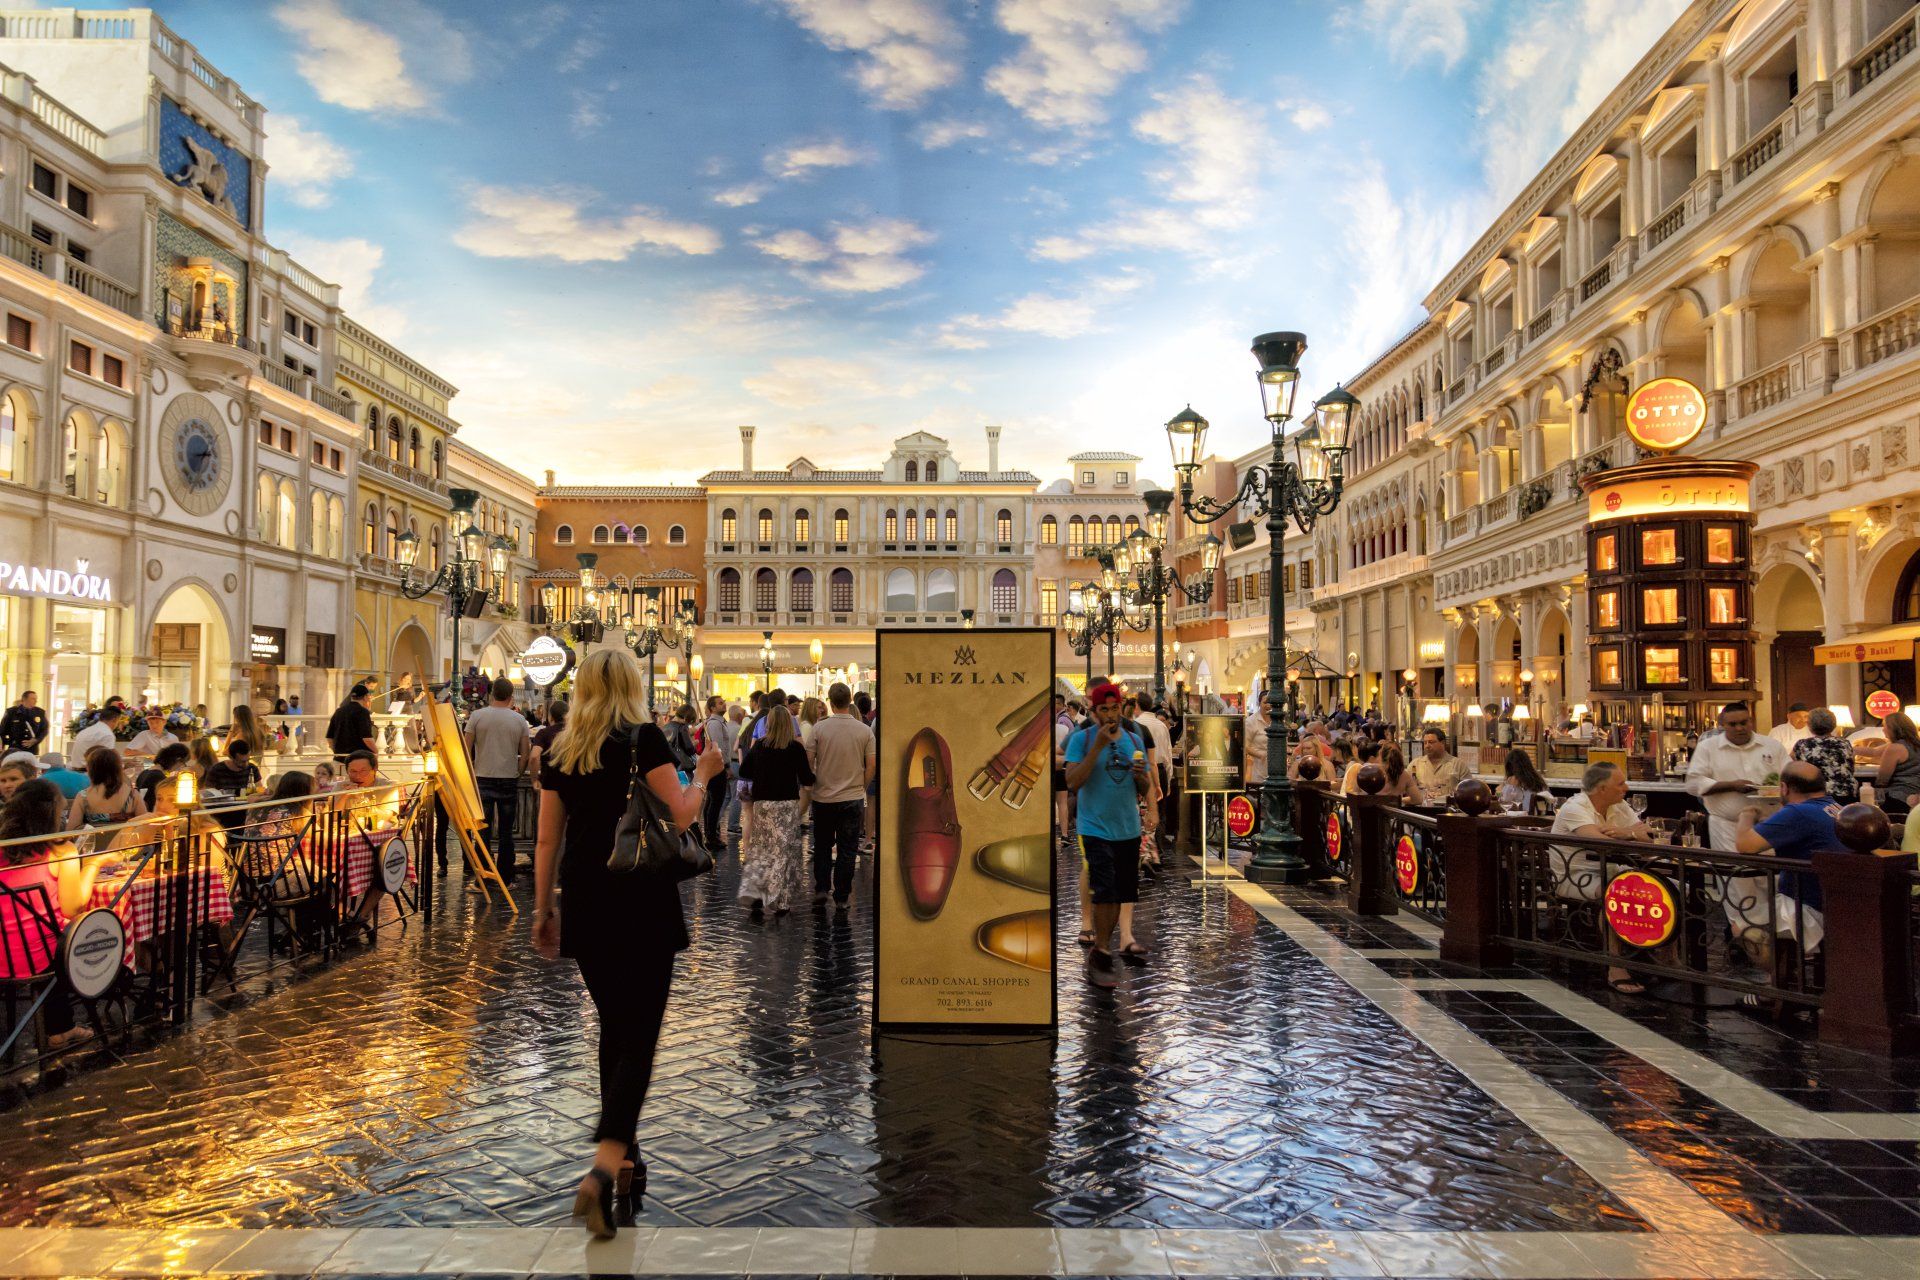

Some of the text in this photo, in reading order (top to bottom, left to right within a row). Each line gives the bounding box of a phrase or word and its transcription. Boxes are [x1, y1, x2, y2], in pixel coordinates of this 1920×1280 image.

[0, 562, 112, 602] PANDORA
[251, 643, 279, 653] HAVING
[1829, 650, 1851, 659] Mario
[904, 671, 1026, 685] MEZLAN
[900, 977, 1031, 987] GRAND CANAL SHOPPES
[975, 999, 993, 1007] 6116
